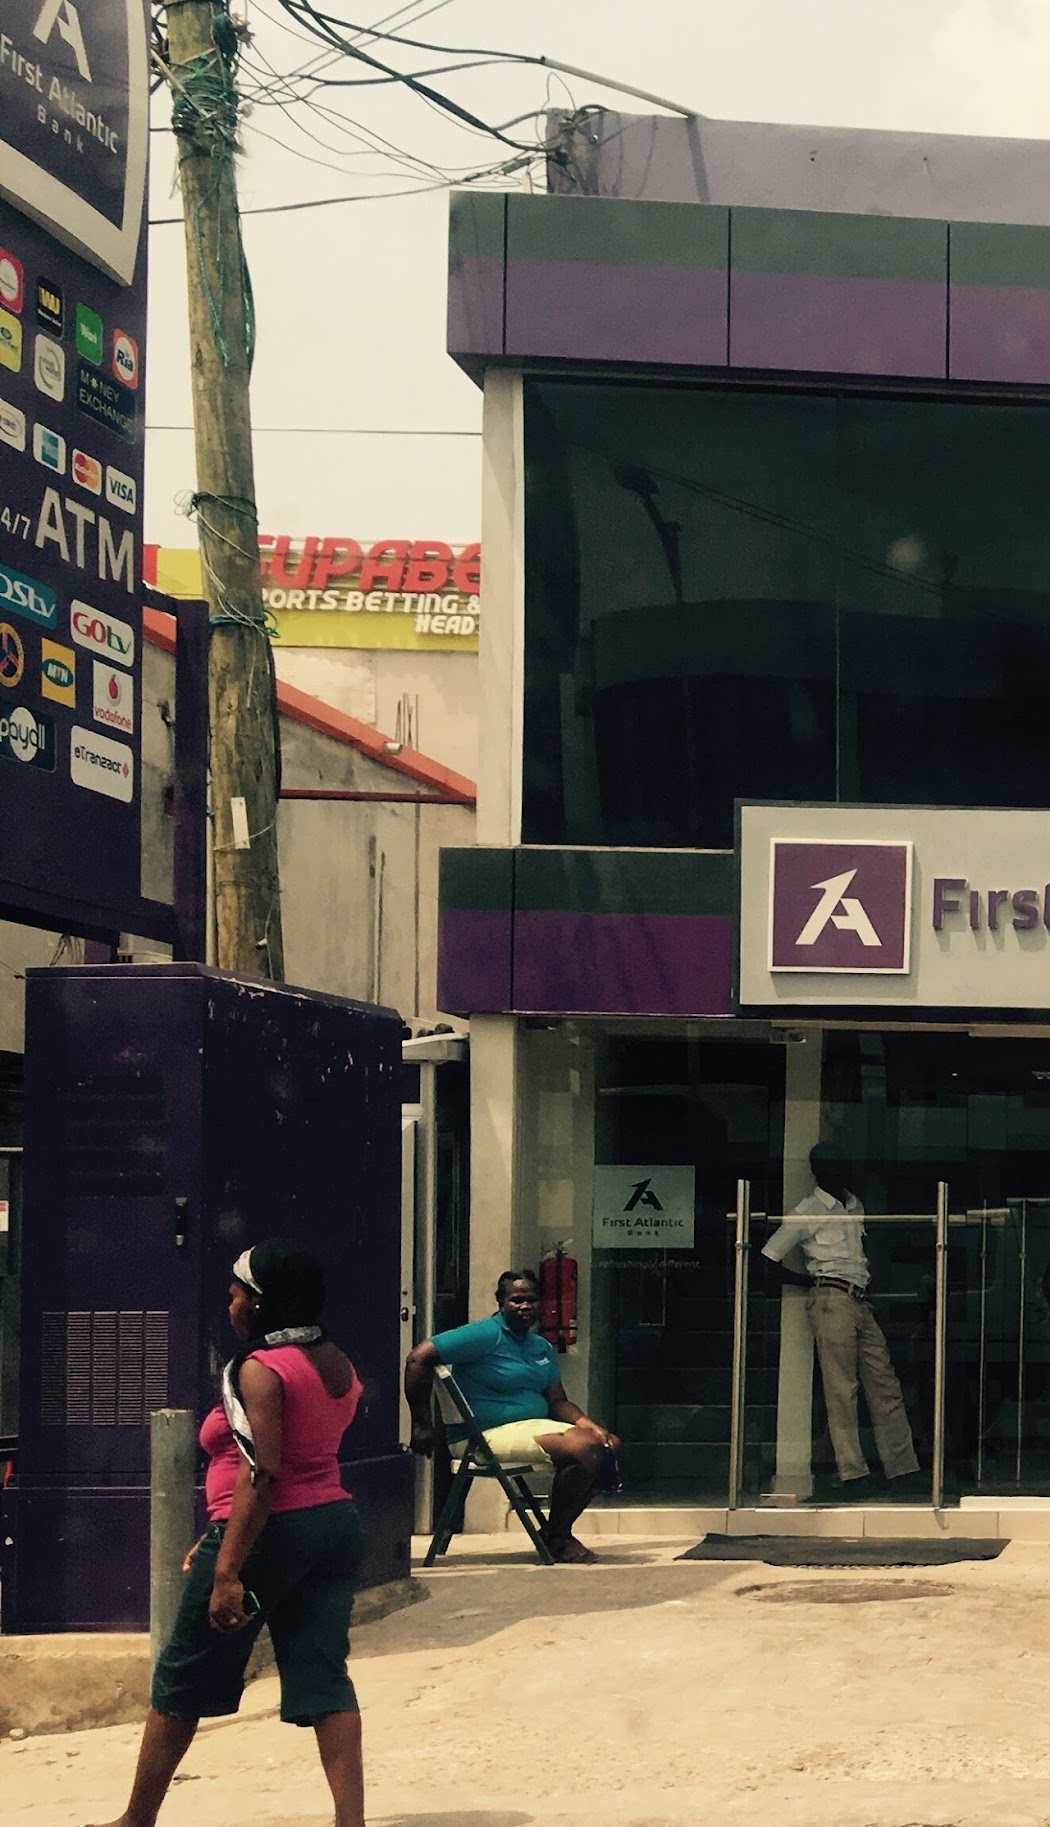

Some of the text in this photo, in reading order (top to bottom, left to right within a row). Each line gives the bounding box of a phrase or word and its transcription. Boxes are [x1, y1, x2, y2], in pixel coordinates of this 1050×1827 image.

[0, 33, 118, 154] First Atlantic
[37, 104, 84, 153] Bank
[117, 348, 133, 373] Ria
[109, 477, 134, 504] VISA
[35, 486, 134, 594] ATM
[262, 588, 338, 610] ORTS
[346, 591, 461, 614] BETTING
[72, 611, 131, 655] GOtv
[415, 614, 475, 636] HEAD
[47, 662, 69, 684] MTN
[93, 705, 132, 730] vodafone
[74, 744, 122, 775] eTranzact
[602, 1217, 684, 1228] First Atlantic
